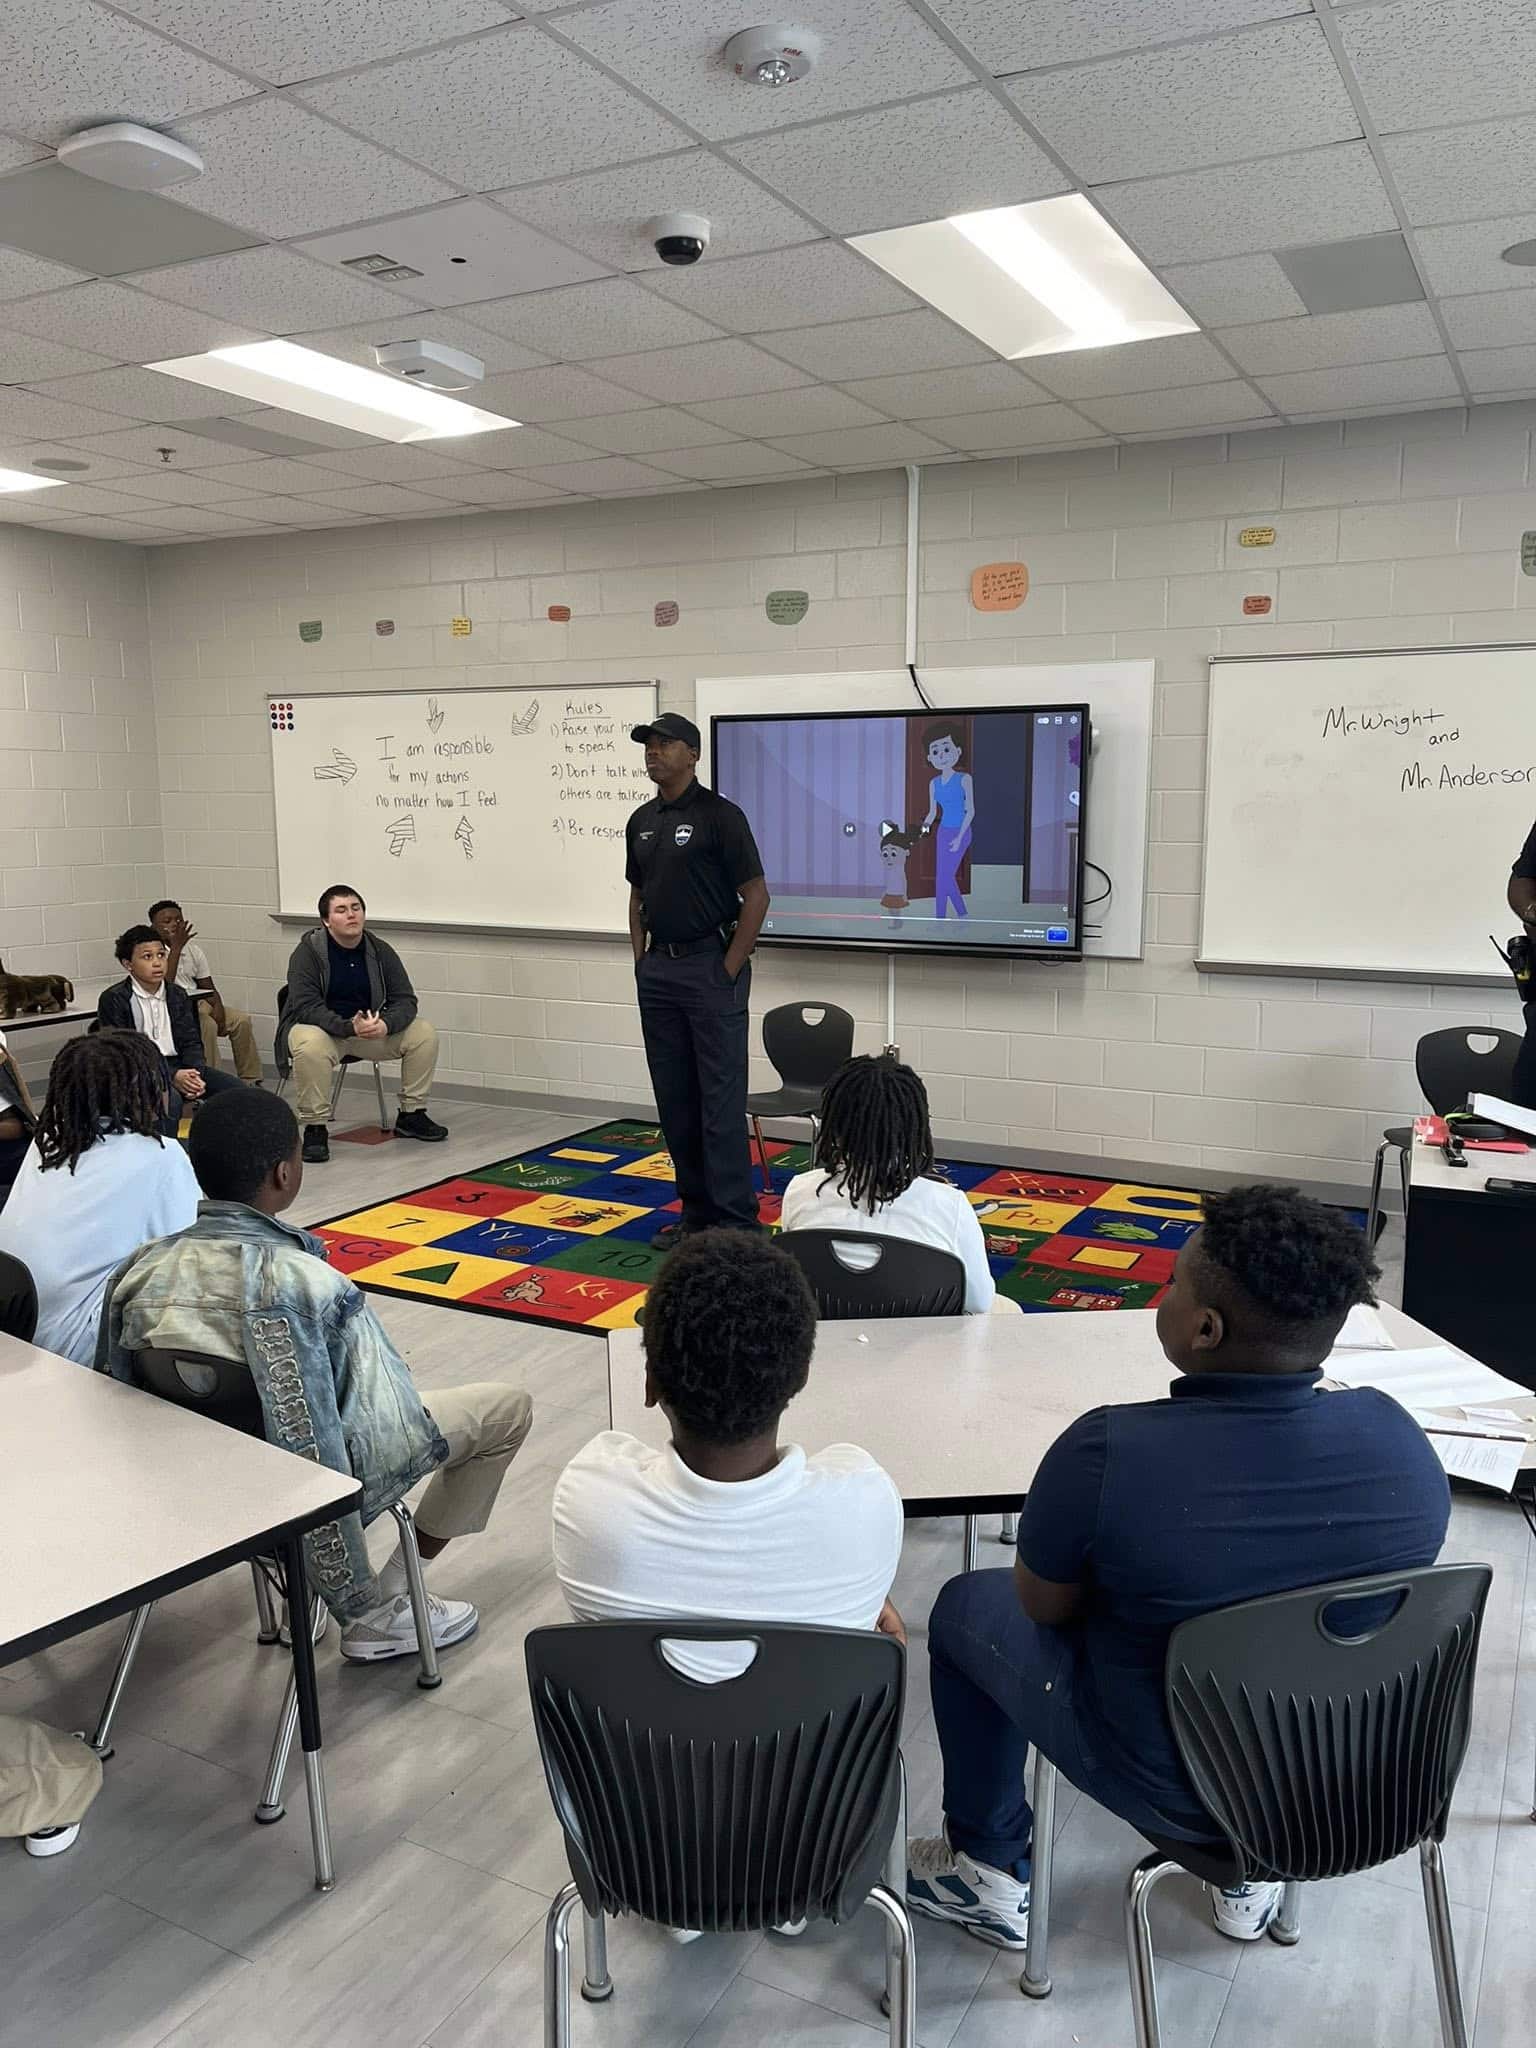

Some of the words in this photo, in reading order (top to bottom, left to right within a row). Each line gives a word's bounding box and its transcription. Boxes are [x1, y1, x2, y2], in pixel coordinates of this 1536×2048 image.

[561, 721, 588, 736] Raise
[1361, 708, 1445, 735] Wright
[1428, 727, 1460, 746] and
[375, 735, 397, 760] I
[406, 743, 425, 757] am
[564, 740, 574, 753] to
[578, 740, 616, 757] speak
[409, 770, 429, 787] my
[606, 764, 628, 778] talk
[375, 794, 390, 807] no
[393, 793, 429, 808] matter
[435, 792, 454, 807] how
[455, 790, 471, 806] I
[477, 791, 497, 806] feel
[559, 787, 592, 801] others
[595, 790, 612, 800] are
[617, 788, 651, 801] talkin
[567, 818, 585, 836] Be
[591, 825, 625, 842] respec
[1000, 1172, 1045, 1187] Xx
[386, 1217, 426, 1230] 7
[1006, 1210, 1054, 1226] Pp
[479, 1222, 523, 1241] Yy
[340, 1240, 393, 1259] Cc
[597, 1251, 653, 1269] 10
[564, 1280, 616, 1300] Kk
